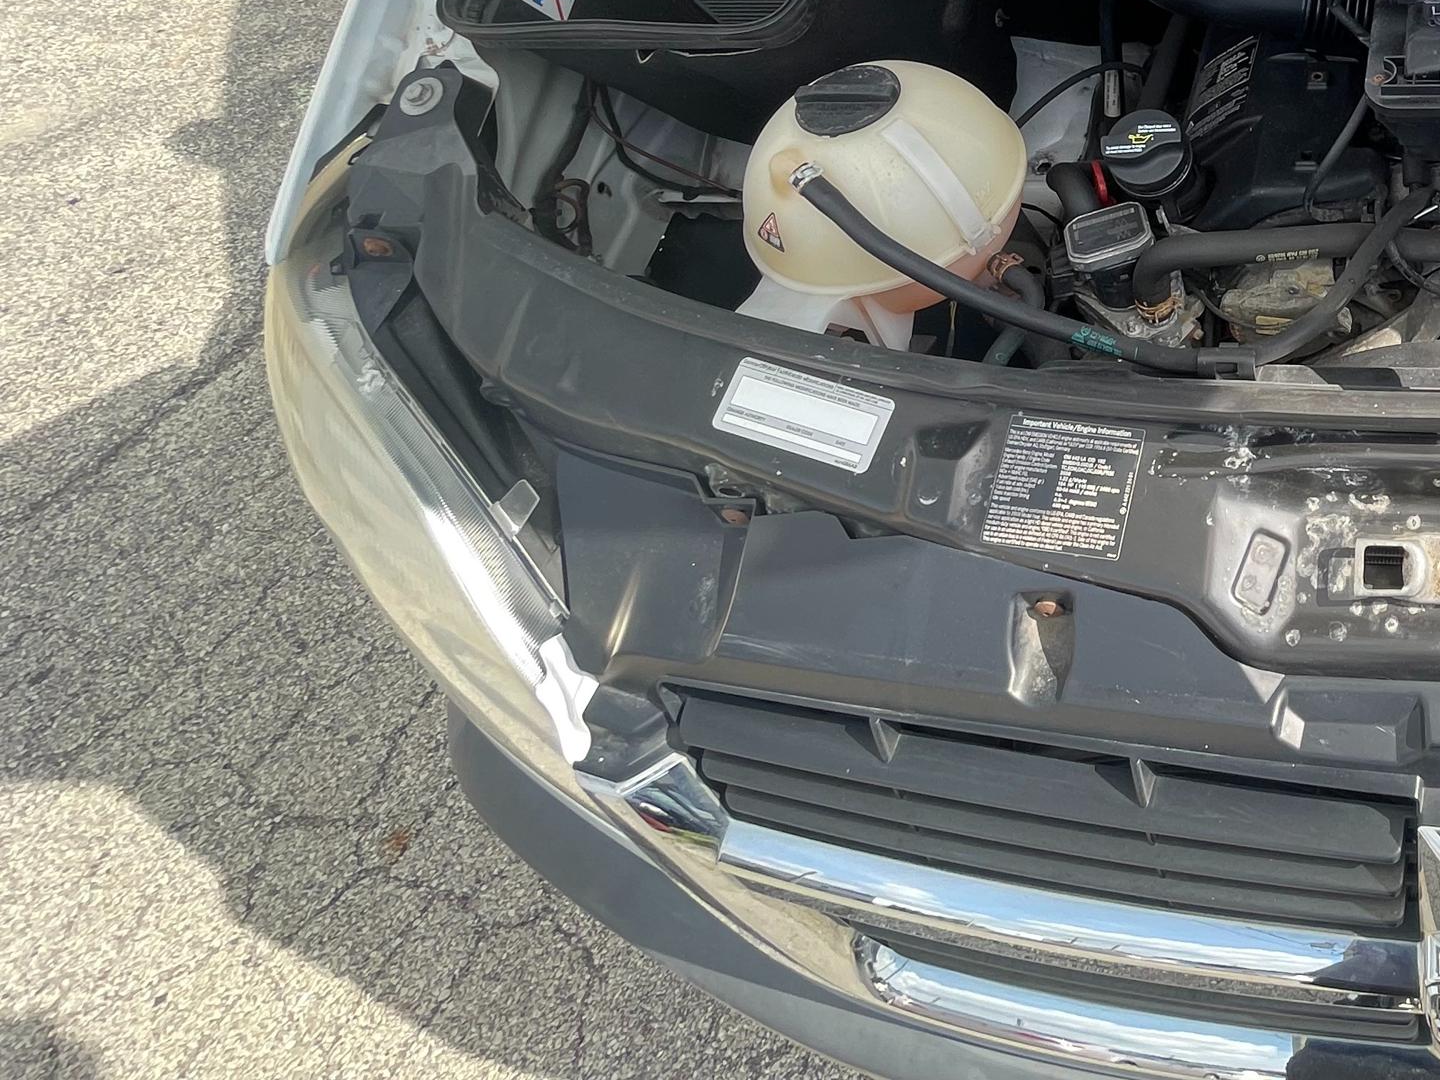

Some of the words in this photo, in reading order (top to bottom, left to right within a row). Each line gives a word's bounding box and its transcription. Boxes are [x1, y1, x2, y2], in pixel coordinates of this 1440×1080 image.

[1022, 418, 1052, 429] Important
[1052, 421, 1097, 434] Vehicle/Engine
[1097, 427, 1132, 437] Information
